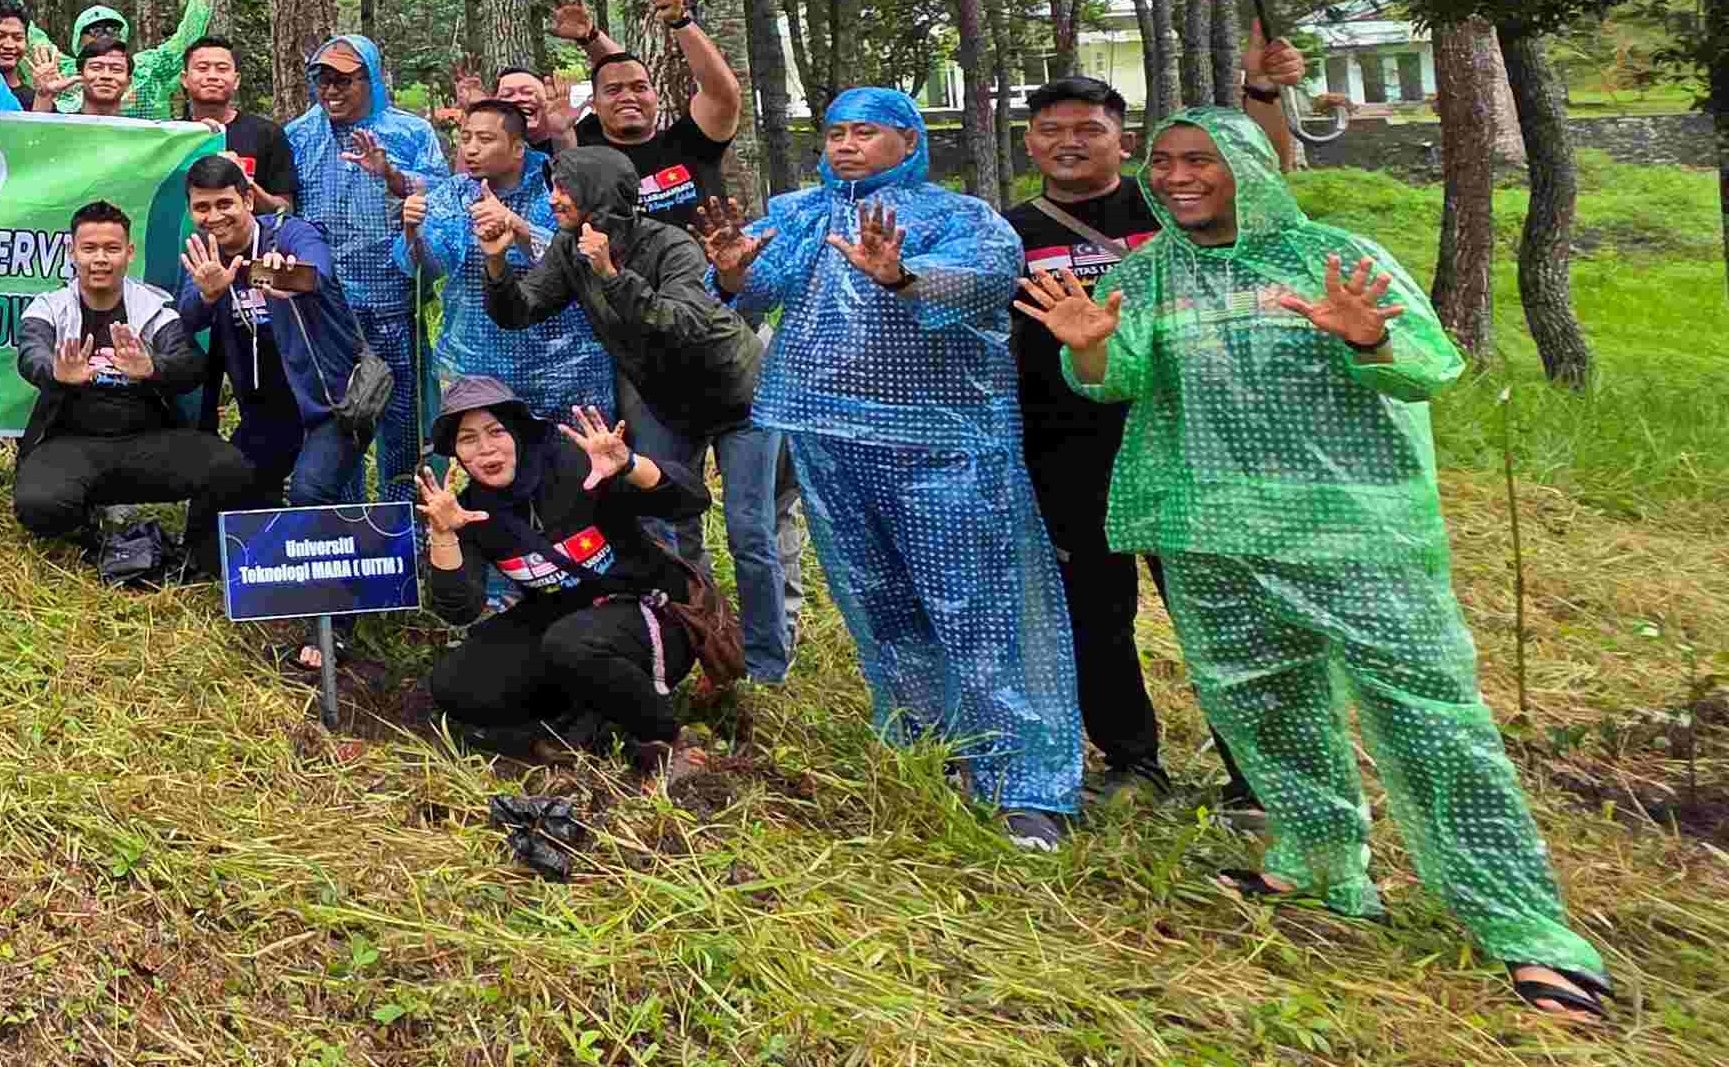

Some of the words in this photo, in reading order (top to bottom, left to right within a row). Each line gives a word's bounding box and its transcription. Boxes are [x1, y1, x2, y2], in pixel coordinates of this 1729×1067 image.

[285, 536, 356, 558] Universiti
[239, 561, 310, 584] Teknologi
[311, 558, 352, 580] MARA
